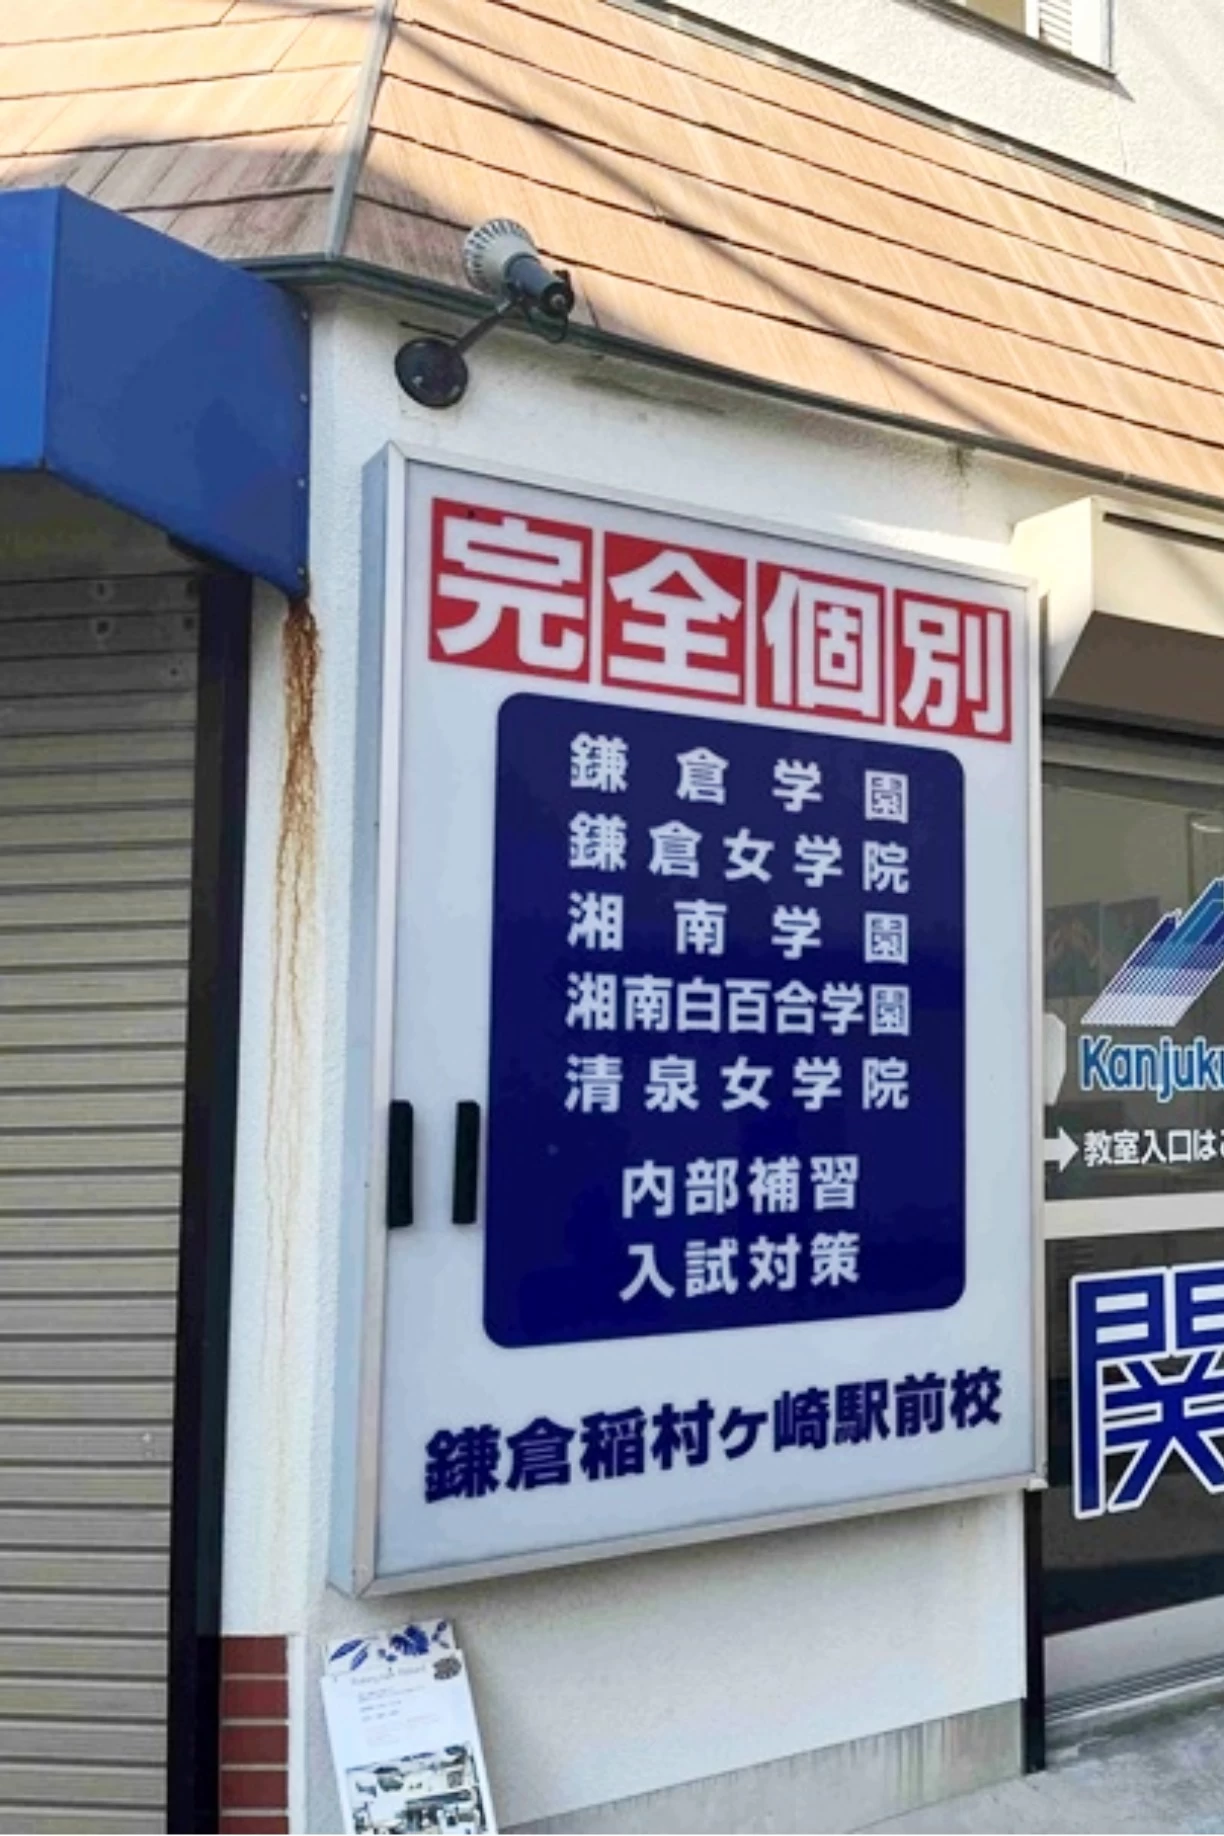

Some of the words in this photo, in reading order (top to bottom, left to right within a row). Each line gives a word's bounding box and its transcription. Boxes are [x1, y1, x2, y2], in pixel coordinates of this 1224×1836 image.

[436, 514, 1008, 735] 完全個別
[570, 733, 909, 824] 鎌倉学園
[568, 812, 910, 893] 鎌倉女学院
[567, 892, 909, 965] 湘南学園
[565, 972, 910, 1036] 湘南白百合学園
[564, 1054, 910, 1112] 清泉女学院
[621, 1155, 861, 1218] 内部補習
[619, 1232, 861, 1301] 入試対策
